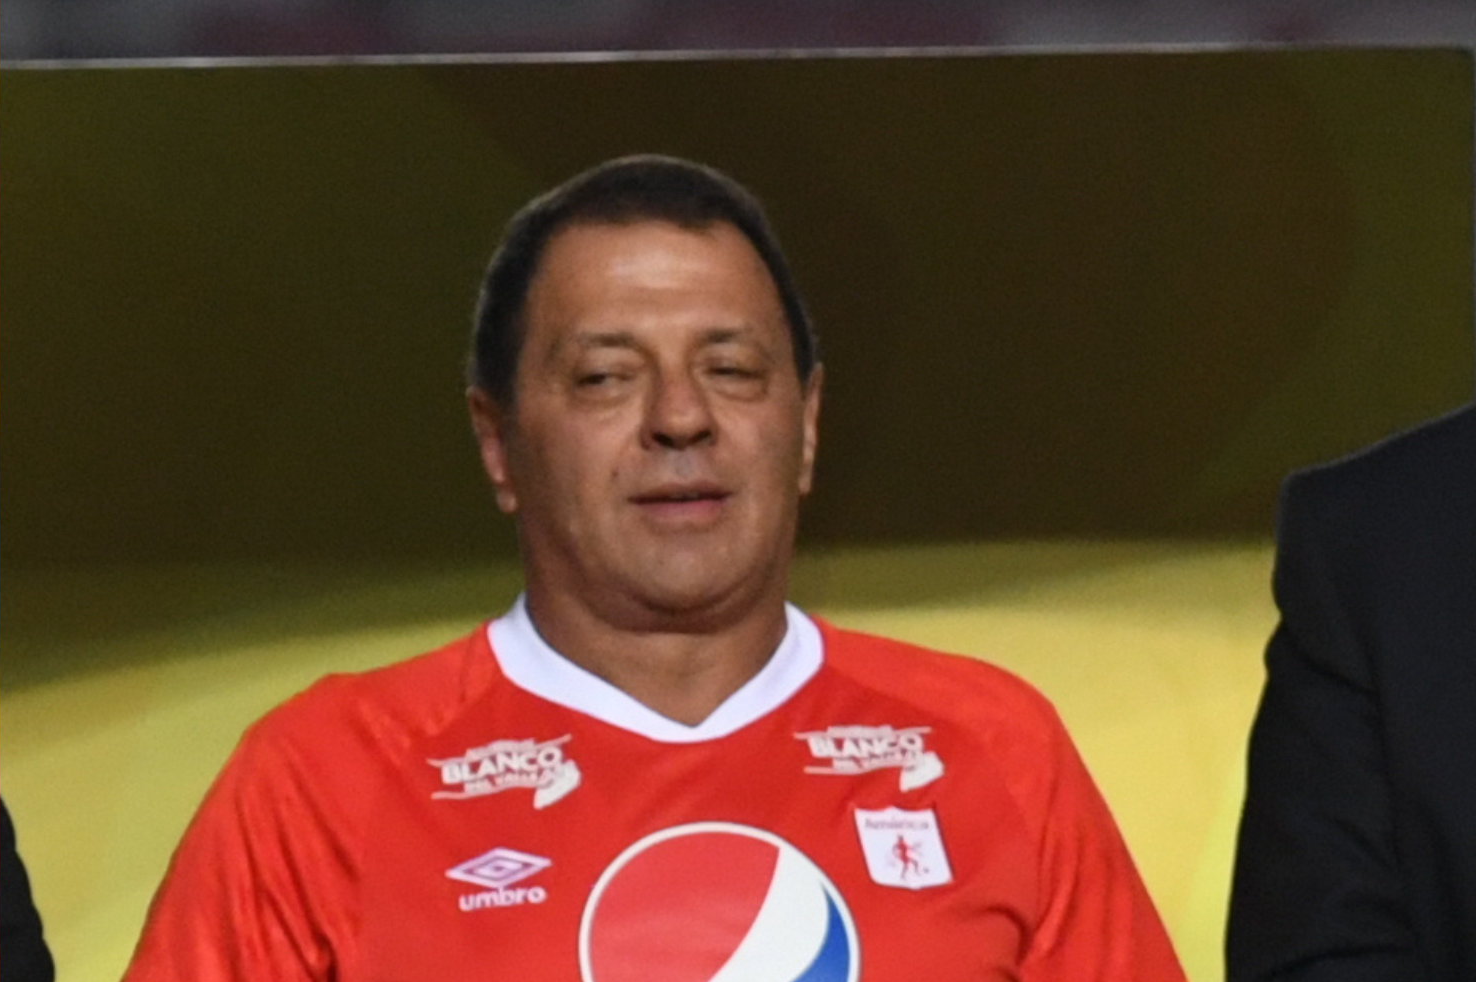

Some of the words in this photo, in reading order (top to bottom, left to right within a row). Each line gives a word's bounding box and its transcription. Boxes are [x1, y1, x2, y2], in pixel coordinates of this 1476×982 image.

[808, 732, 924, 758] BLANCO
[441, 747, 563, 785] BLANCO
[459, 885, 547, 911] umbro
